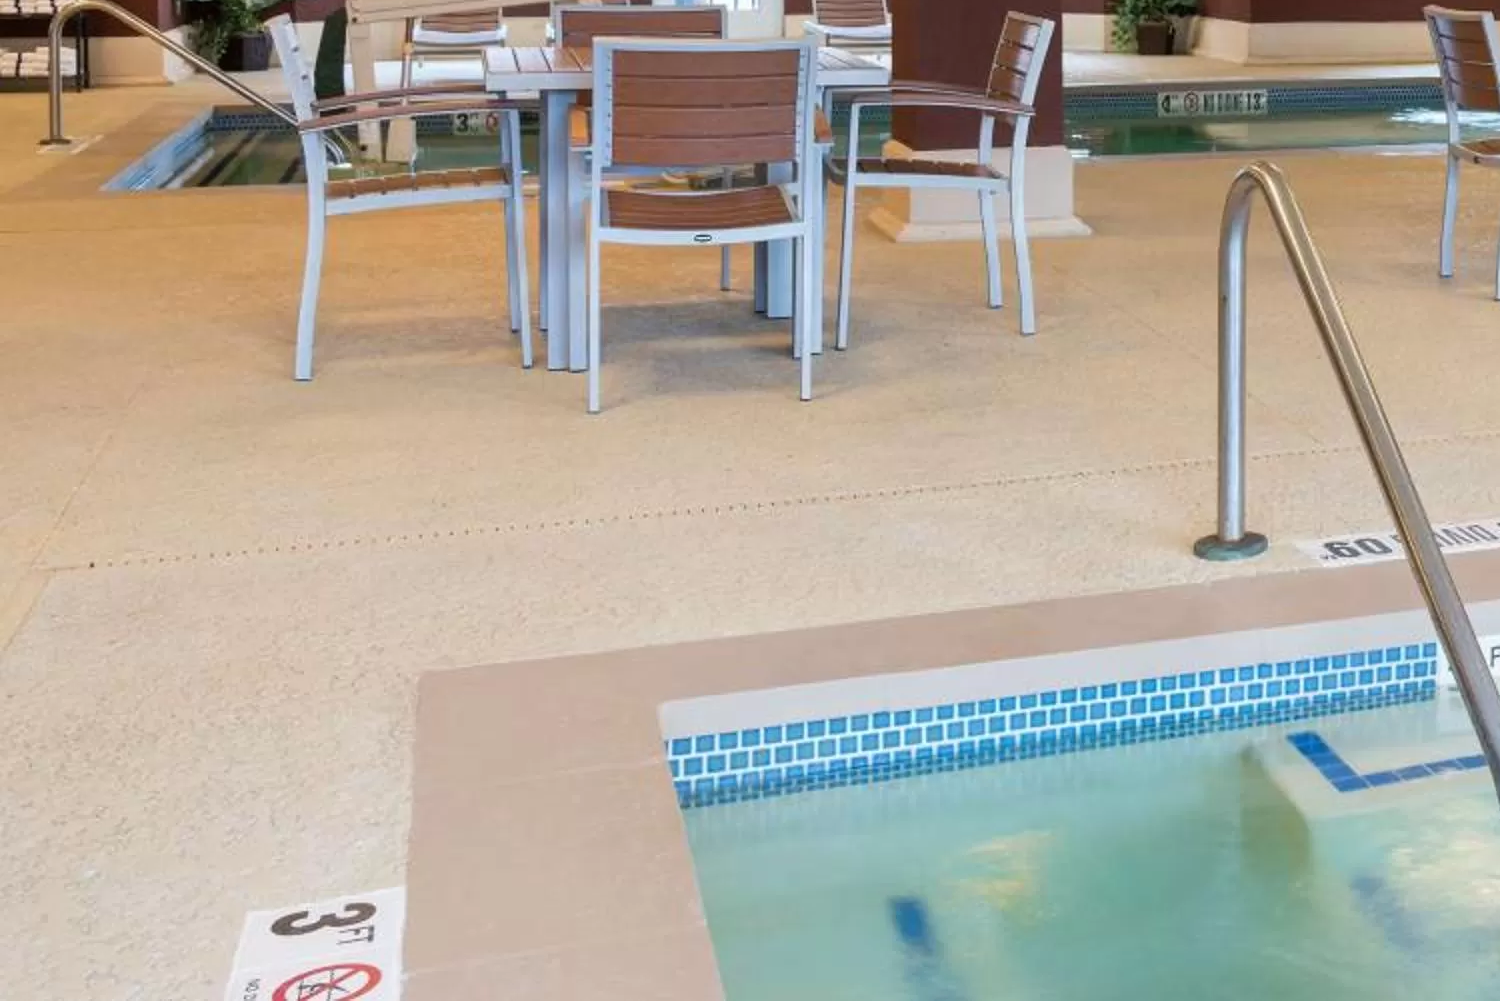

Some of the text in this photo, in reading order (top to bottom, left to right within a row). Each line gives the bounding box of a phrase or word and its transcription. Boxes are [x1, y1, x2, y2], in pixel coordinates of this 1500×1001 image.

[456, 113, 469, 133] 3
[270, 902, 377, 945] 3 FT
